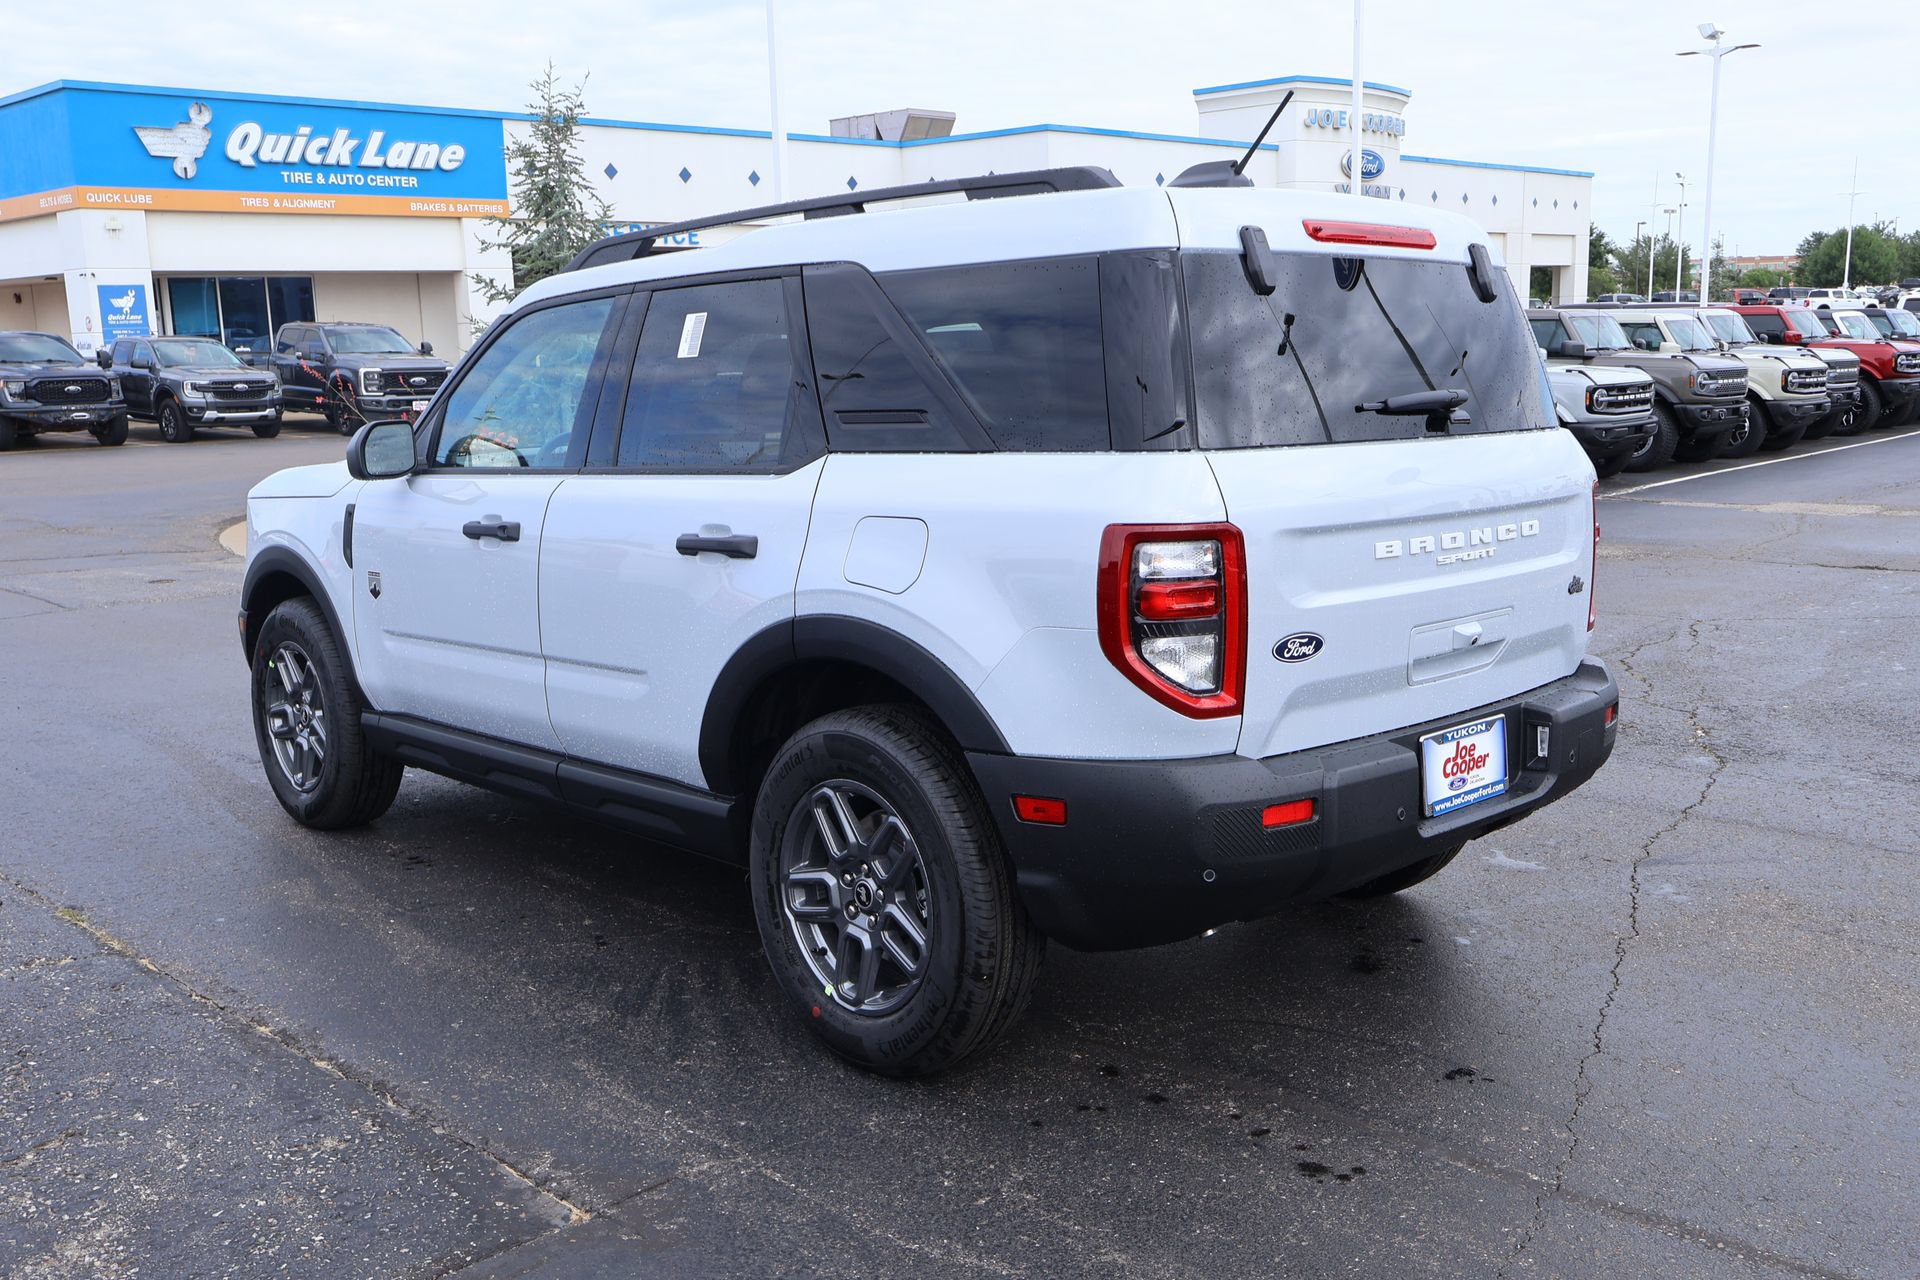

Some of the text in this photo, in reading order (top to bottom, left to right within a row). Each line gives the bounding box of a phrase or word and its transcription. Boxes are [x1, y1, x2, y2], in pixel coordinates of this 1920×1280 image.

[1305, 109, 1347, 129] JOE
[225, 121, 466, 171] Quick Lane
[281, 171, 418, 188] TIRE & AUTO CENTER
[86, 193, 152, 204] QUICK LUBE
[1336, 184, 1391, 200] YKON
[241, 197, 336, 209] TIRES & ALIGNMENT
[410, 203, 446, 212] BRAKES
[457, 204, 503, 213] BATTERIES
[1375, 519, 1540, 559] BRONCO
[1436, 547, 1497, 566] SPORT
[1446, 723, 1486, 740] YUKON
[1452, 740, 1476, 762] Joe
[1443, 752, 1490, 779] Cooper
[1434, 783, 1504, 812] www.JoeCooperFord.com
